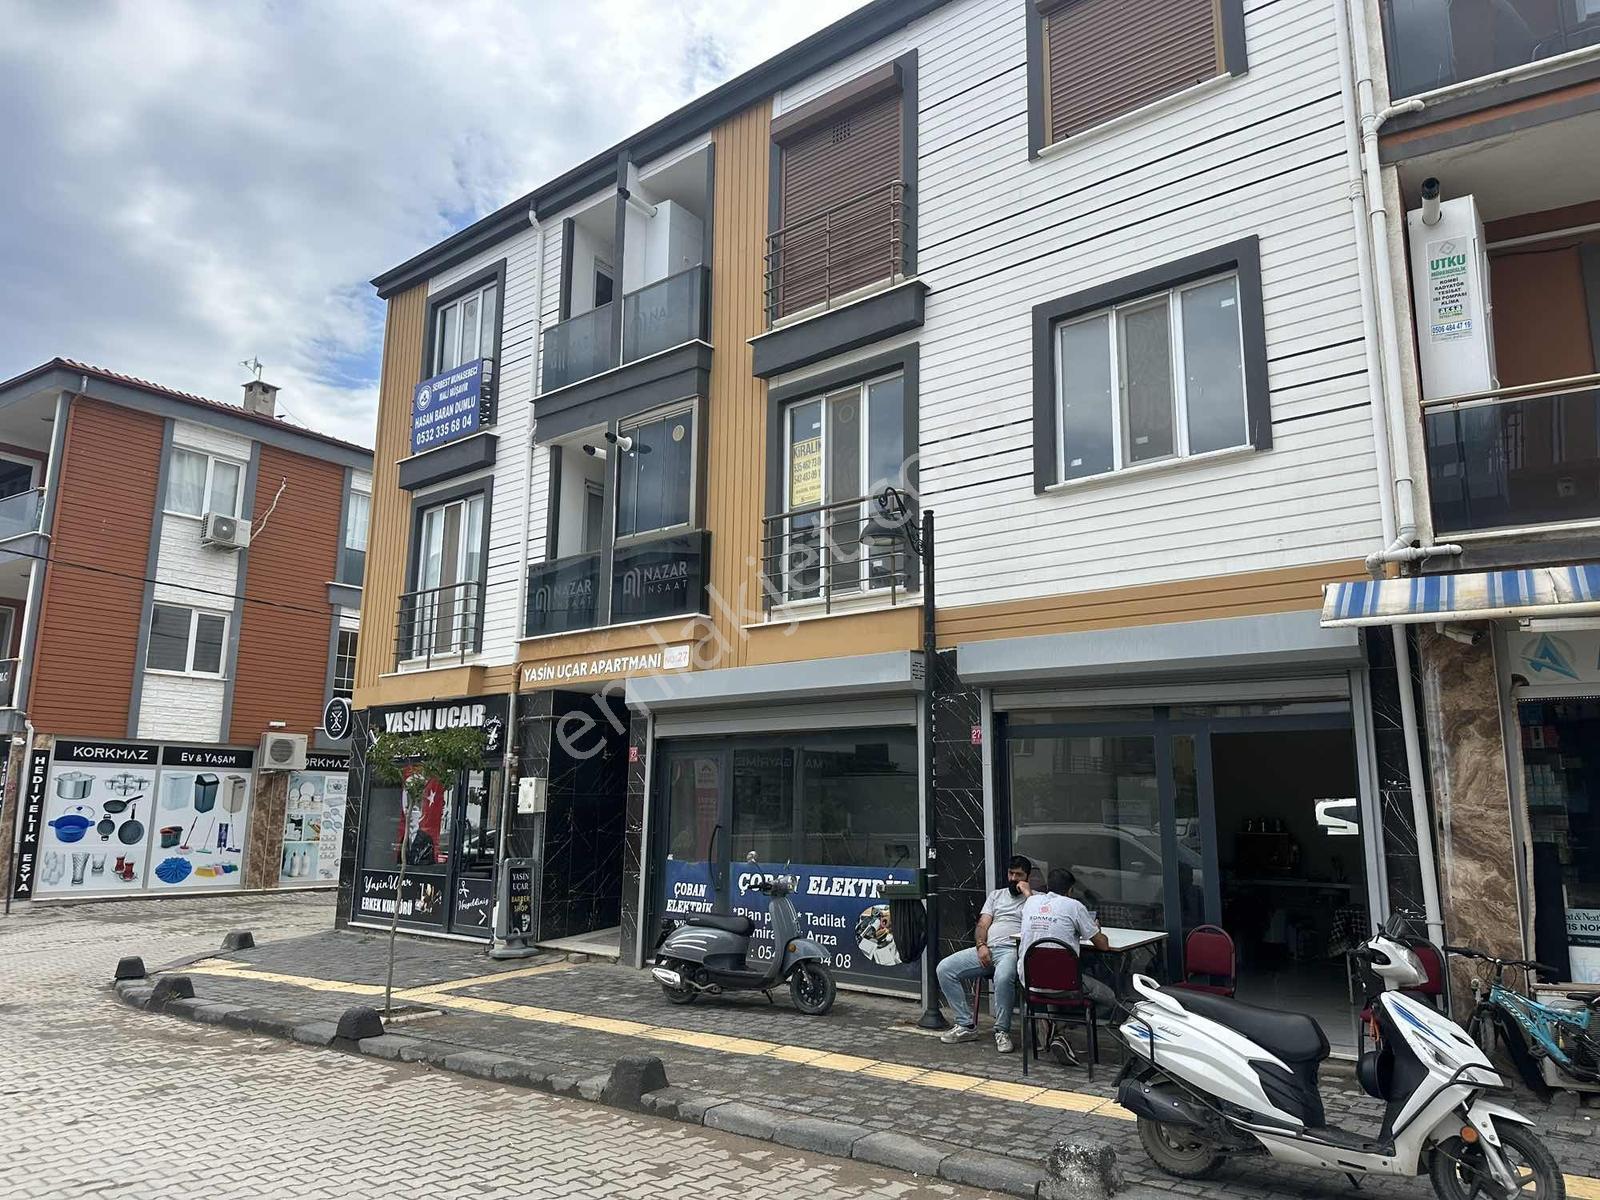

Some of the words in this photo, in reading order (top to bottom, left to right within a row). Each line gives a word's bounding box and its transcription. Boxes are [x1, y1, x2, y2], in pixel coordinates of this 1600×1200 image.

[1430, 254, 1466, 271] UTKU
[432, 377, 451, 392] SERBEST
[414, 411, 434, 429] HASAN
[434, 403, 454, 421] BARAN
[454, 396, 476, 414] DUMLU
[416, 428, 434, 445] 0532
[435, 422, 449, 438] 335
[450, 418, 461, 433] 68
[462, 413, 472, 429] 04
[643, 560, 688, 582] NAZAR
[524, 663, 555, 682] YASİN
[557, 661, 588, 682] UÇAR
[589, 653, 662, 675] APARTMANI
[384, 706, 434, 733] YASİN
[972, 729, 981, 739] 27
[73, 746, 149, 760] KORKMAZ
[196, 754, 202, 763] &
[305, 757, 350, 768] ORKMAZ
[17, 853, 33, 892] EŞYA
[387, 875, 414, 892] Uar
[674, 882, 707, 898] ÇOBAN
[806, 874, 910, 899] ELEKTR
[361, 896, 382, 912] ERKEK
[381, 898, 413, 916] KUAÖRÜ
[665, 899, 714, 914] ELEKTRİK
[805, 912, 846, 929] Tadilat
[835, 953, 852, 969] 08
